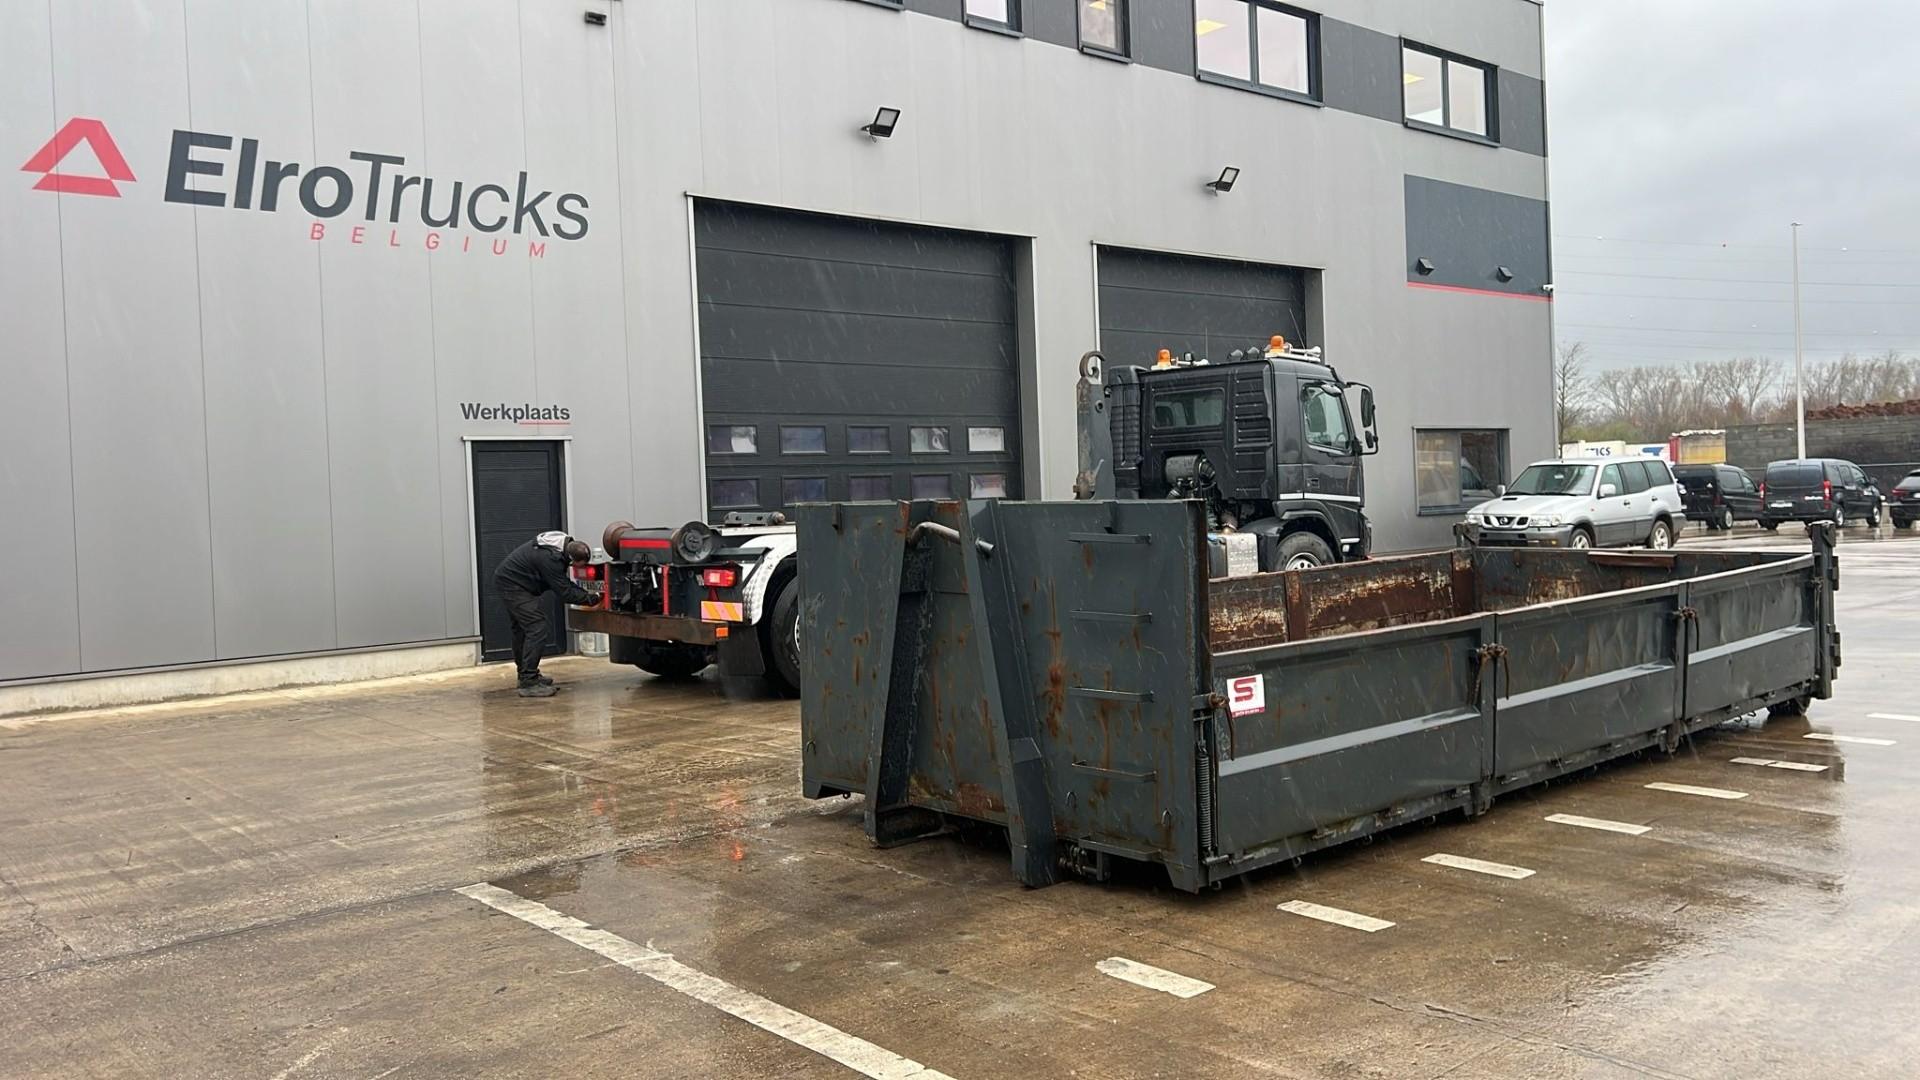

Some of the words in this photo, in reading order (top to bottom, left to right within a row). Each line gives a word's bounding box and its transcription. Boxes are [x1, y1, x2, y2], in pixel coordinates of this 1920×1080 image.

[164, 129, 590, 241] ElroTrucks
[310, 222, 547, 259] BELGIUM
[460, 403, 571, 424] Werkplaats
